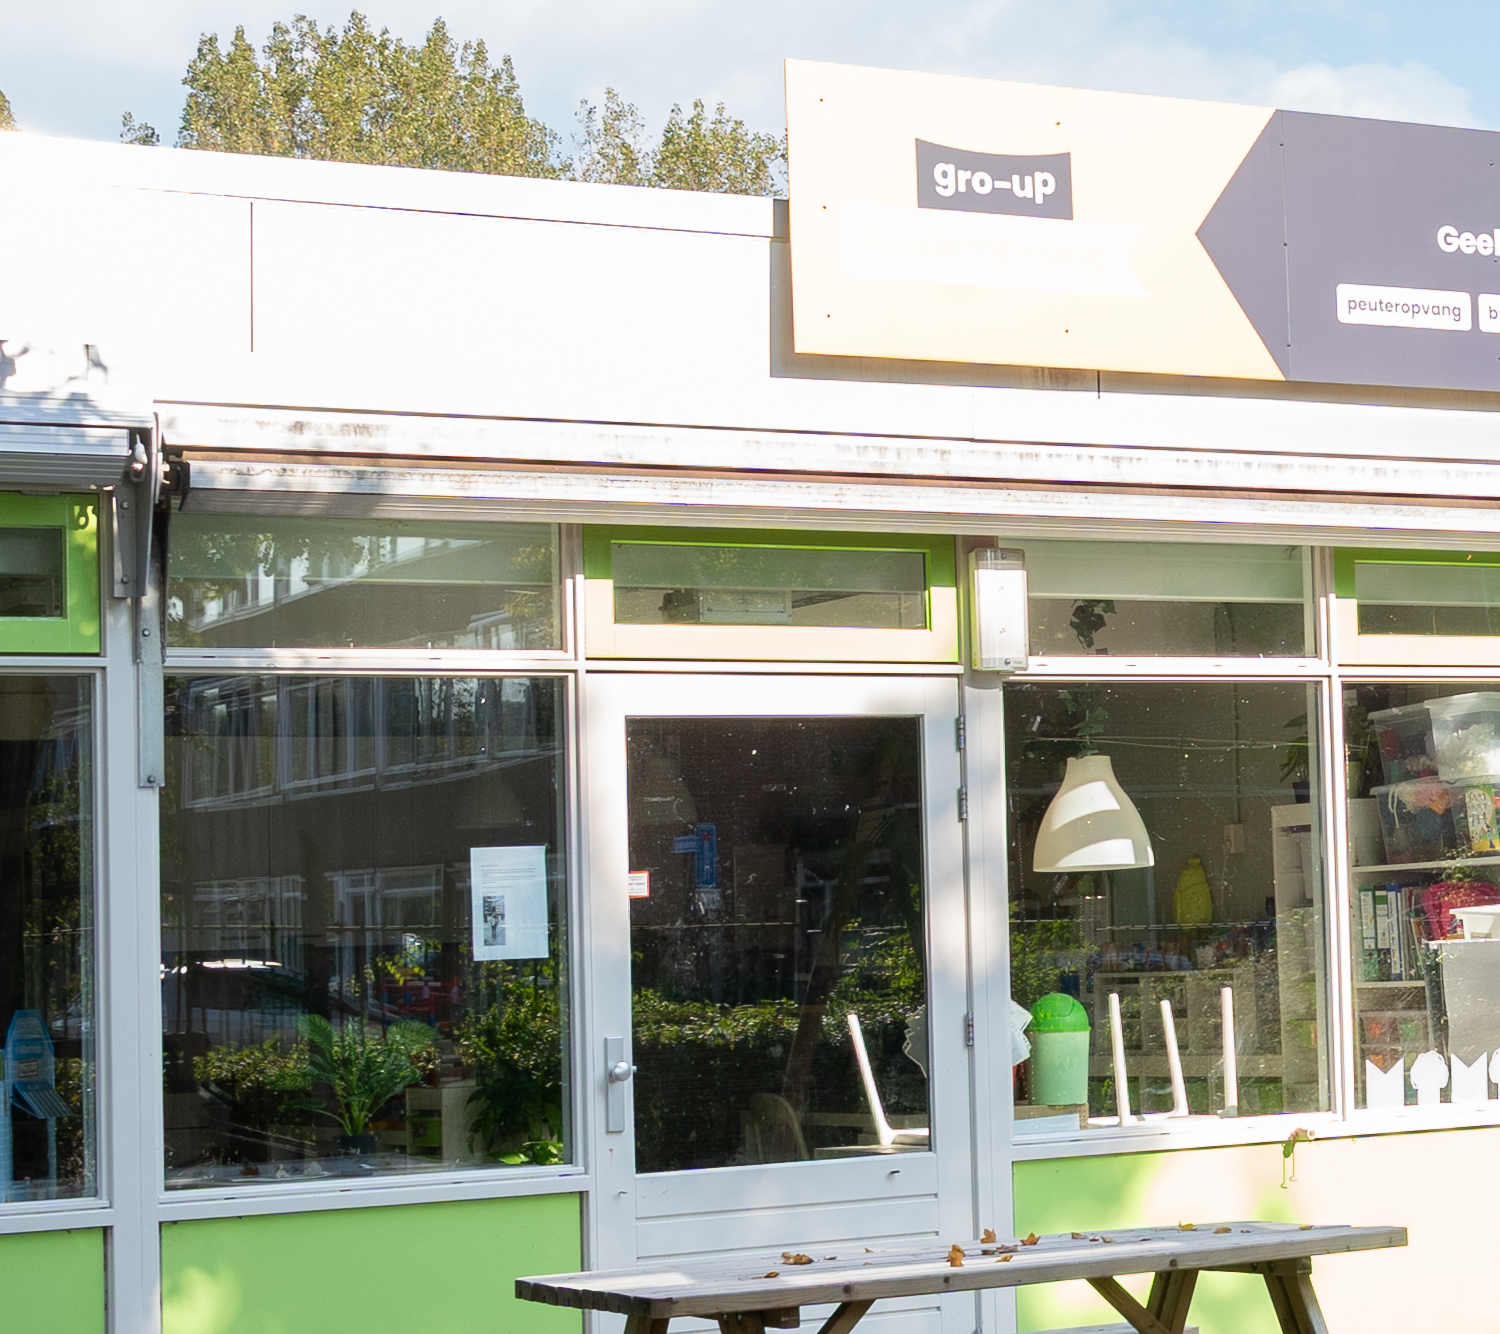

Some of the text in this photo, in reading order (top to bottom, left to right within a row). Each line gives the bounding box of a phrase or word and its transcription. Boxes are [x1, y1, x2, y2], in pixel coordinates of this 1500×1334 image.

[933, 161, 1056, 205] gro-up
[865, 223, 1107, 279] kinderopvang
[1348, 298, 1461, 322] peuteropvang
